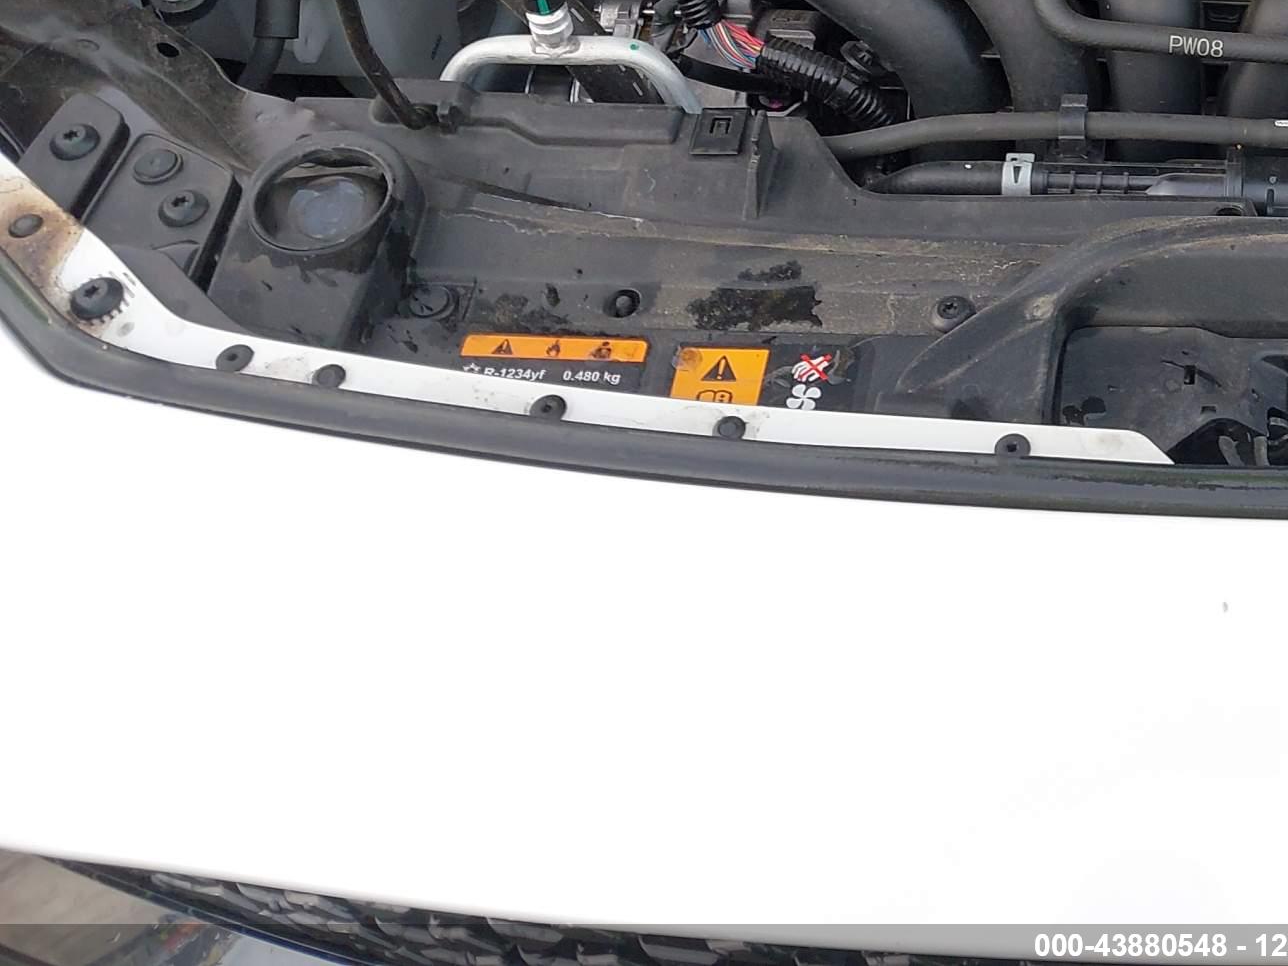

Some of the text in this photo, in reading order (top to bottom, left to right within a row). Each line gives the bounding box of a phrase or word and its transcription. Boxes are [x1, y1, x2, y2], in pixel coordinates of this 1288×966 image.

[1167, 33, 1224, 57] PW08
[483, 366, 621, 385] R-1234yf 0.480 kg
